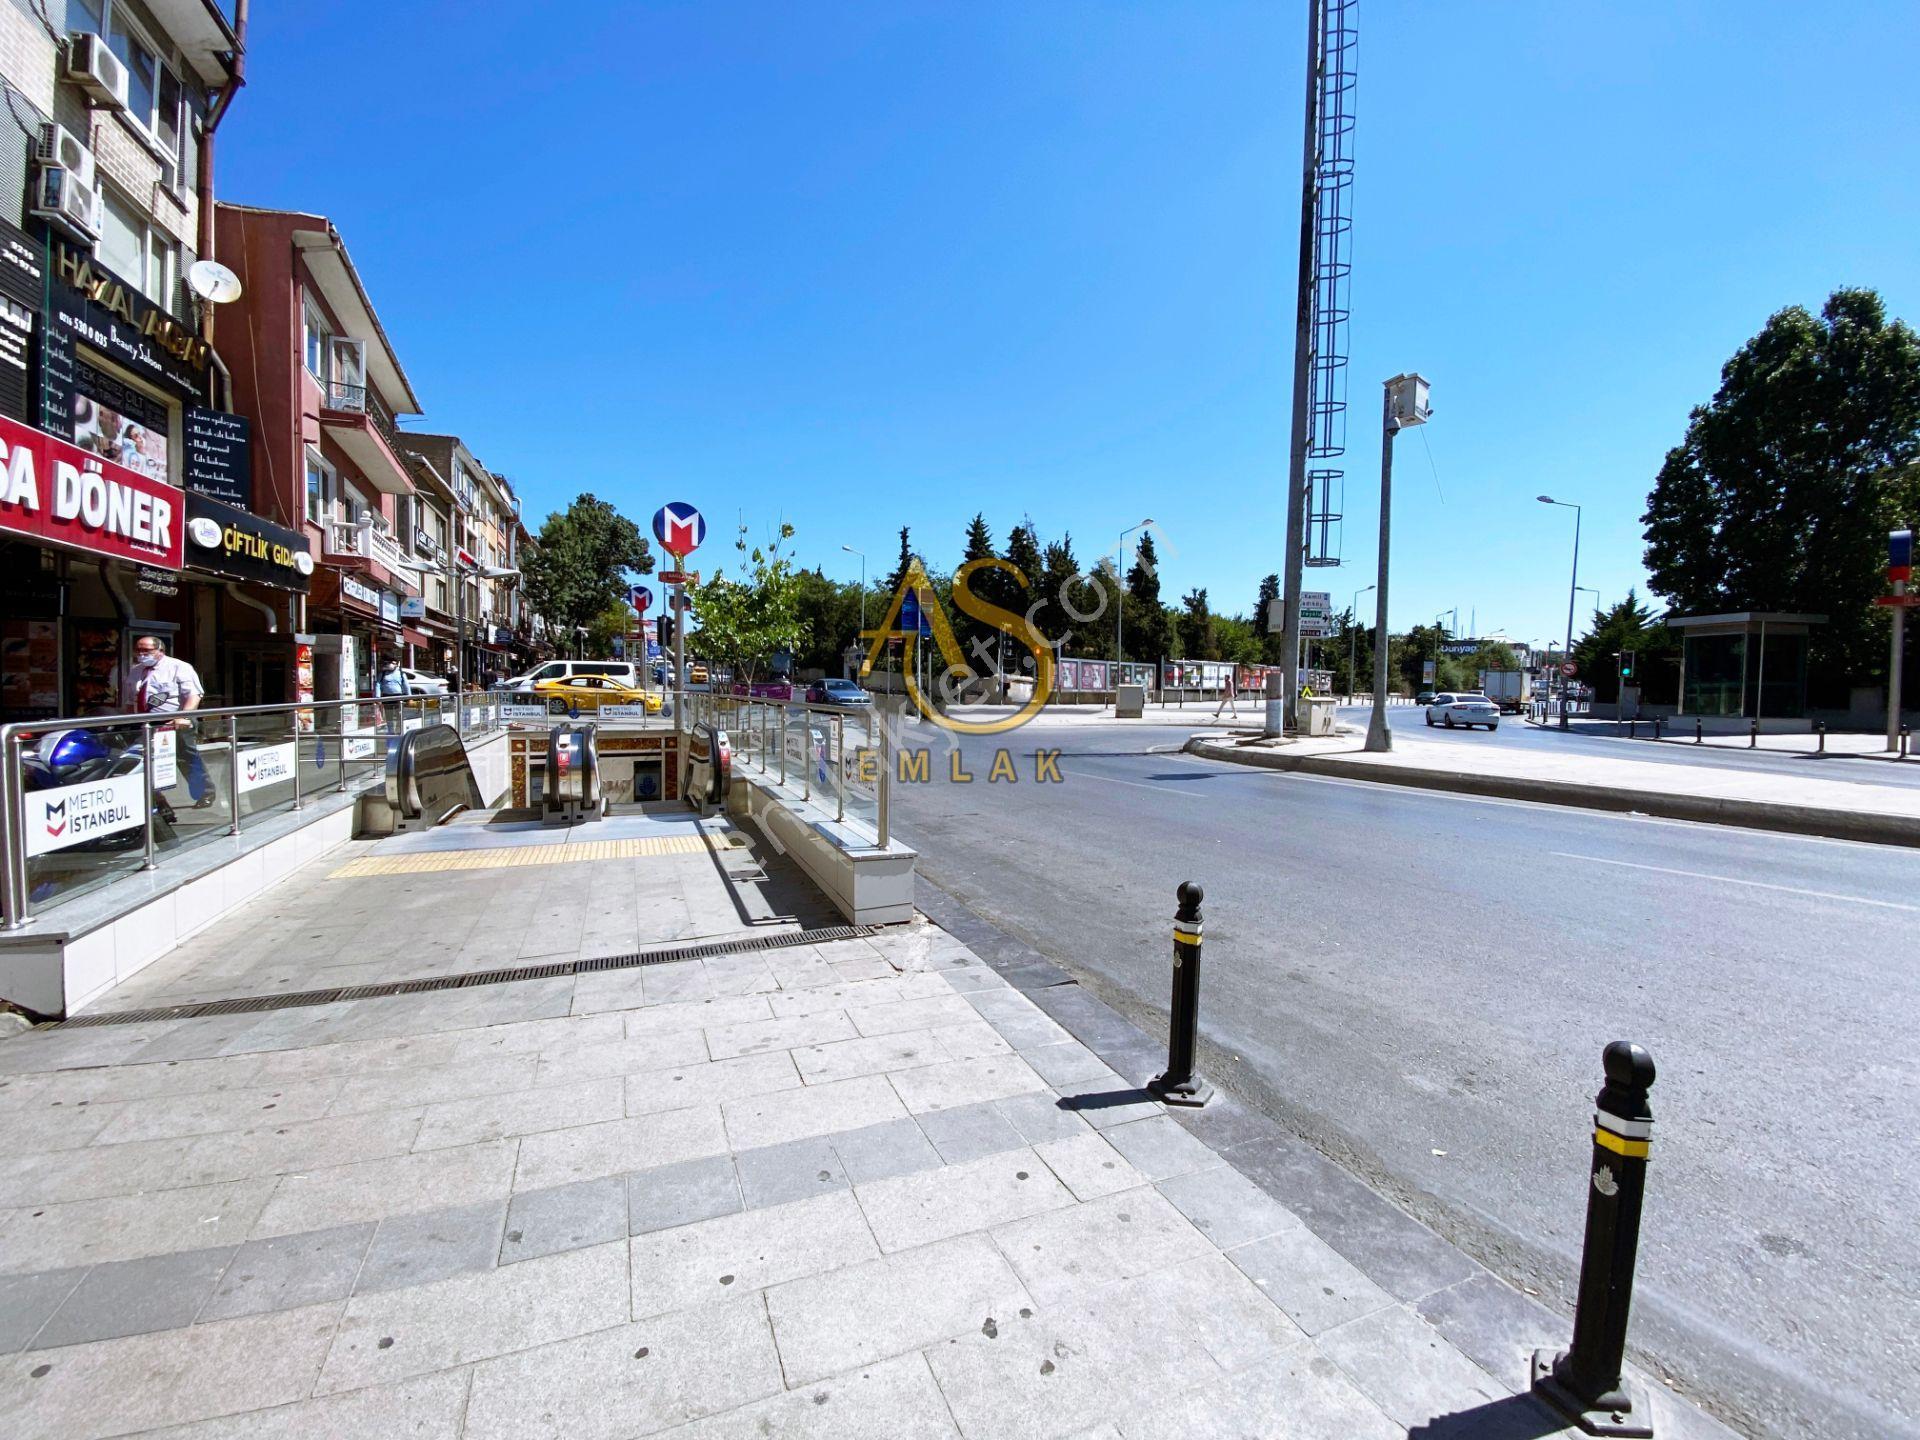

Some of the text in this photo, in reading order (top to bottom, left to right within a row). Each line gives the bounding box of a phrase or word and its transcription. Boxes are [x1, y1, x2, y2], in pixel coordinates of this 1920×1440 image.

[59, 242, 142, 329] HAZAL
[74, 317, 87, 334] 530
[88, 327, 94, 339] 0
[94, 330, 108, 348] 035
[110, 324, 138, 360] Beauty
[138, 344, 162, 371] Saloon
[52, 457, 172, 549] DÖNER
[223, 523, 269, 561] ÇİFTLİK
[272, 544, 295, 568] GIDA
[69, 787, 114, 812] METRO
[70, 805, 131, 834] İSTANBUL
